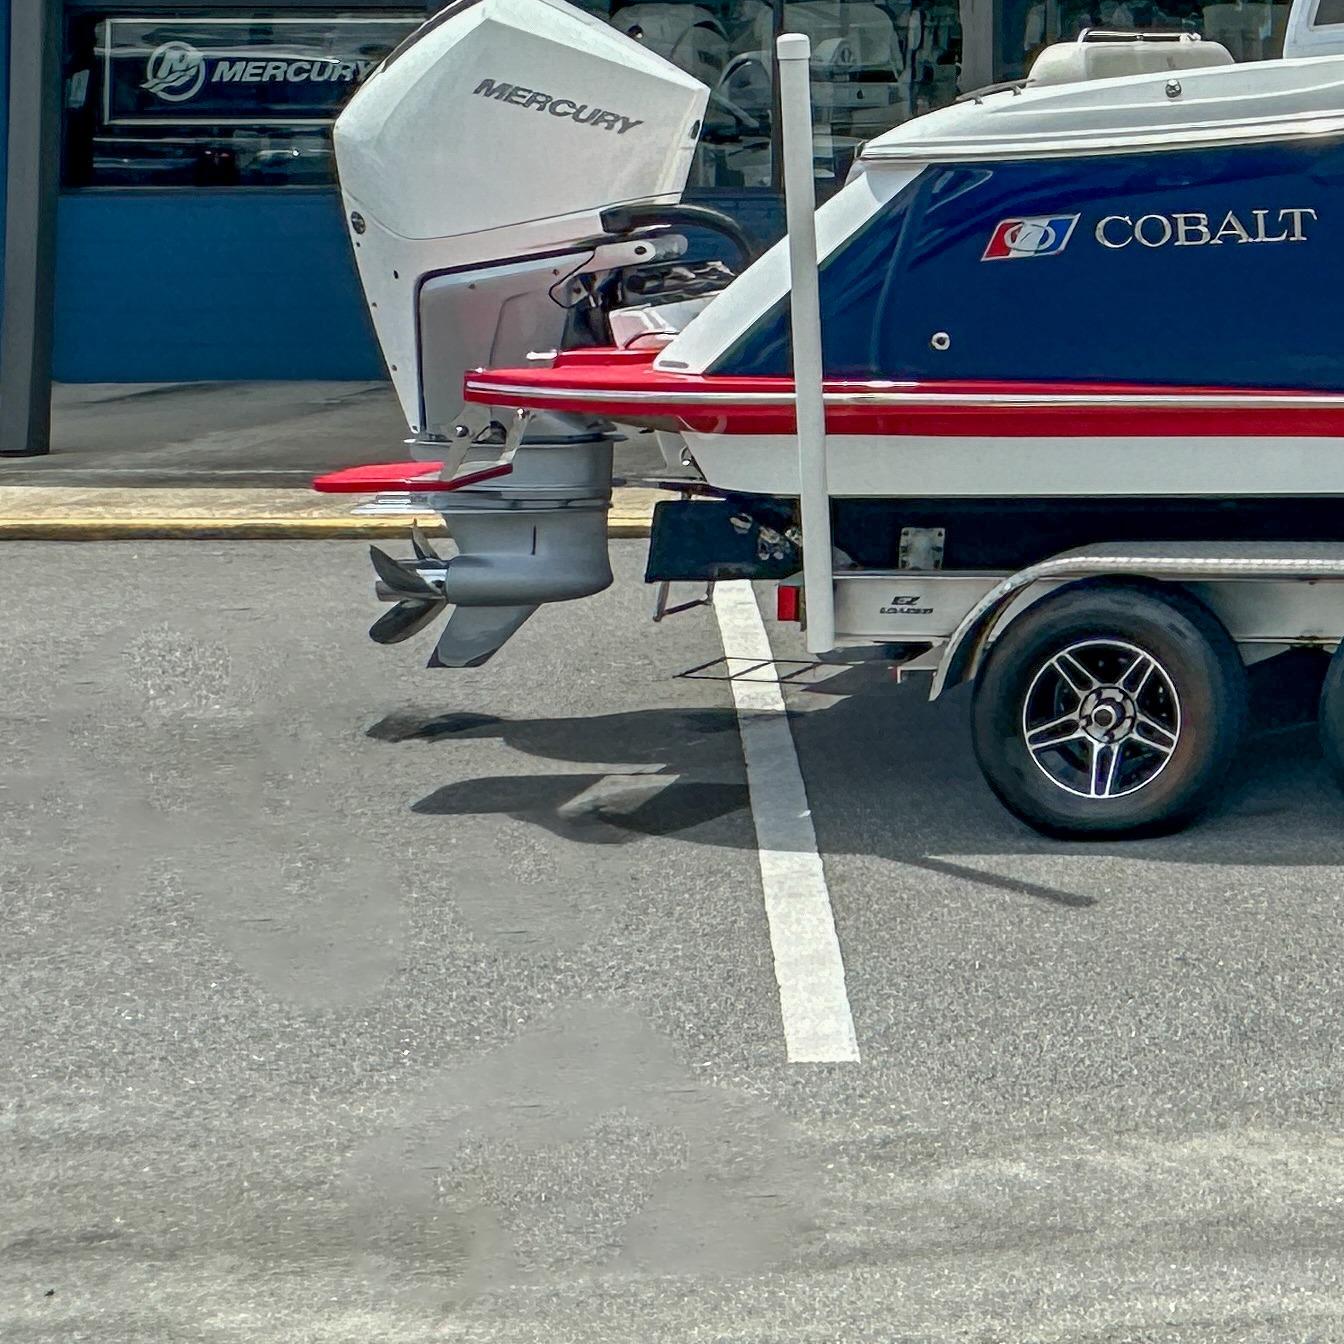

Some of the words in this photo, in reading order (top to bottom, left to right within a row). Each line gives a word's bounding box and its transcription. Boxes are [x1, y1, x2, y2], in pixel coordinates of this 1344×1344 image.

[211, 59, 376, 84] MERCURY
[472, 78, 645, 135] MERCURY
[1095, 208, 1317, 249] COBALT
